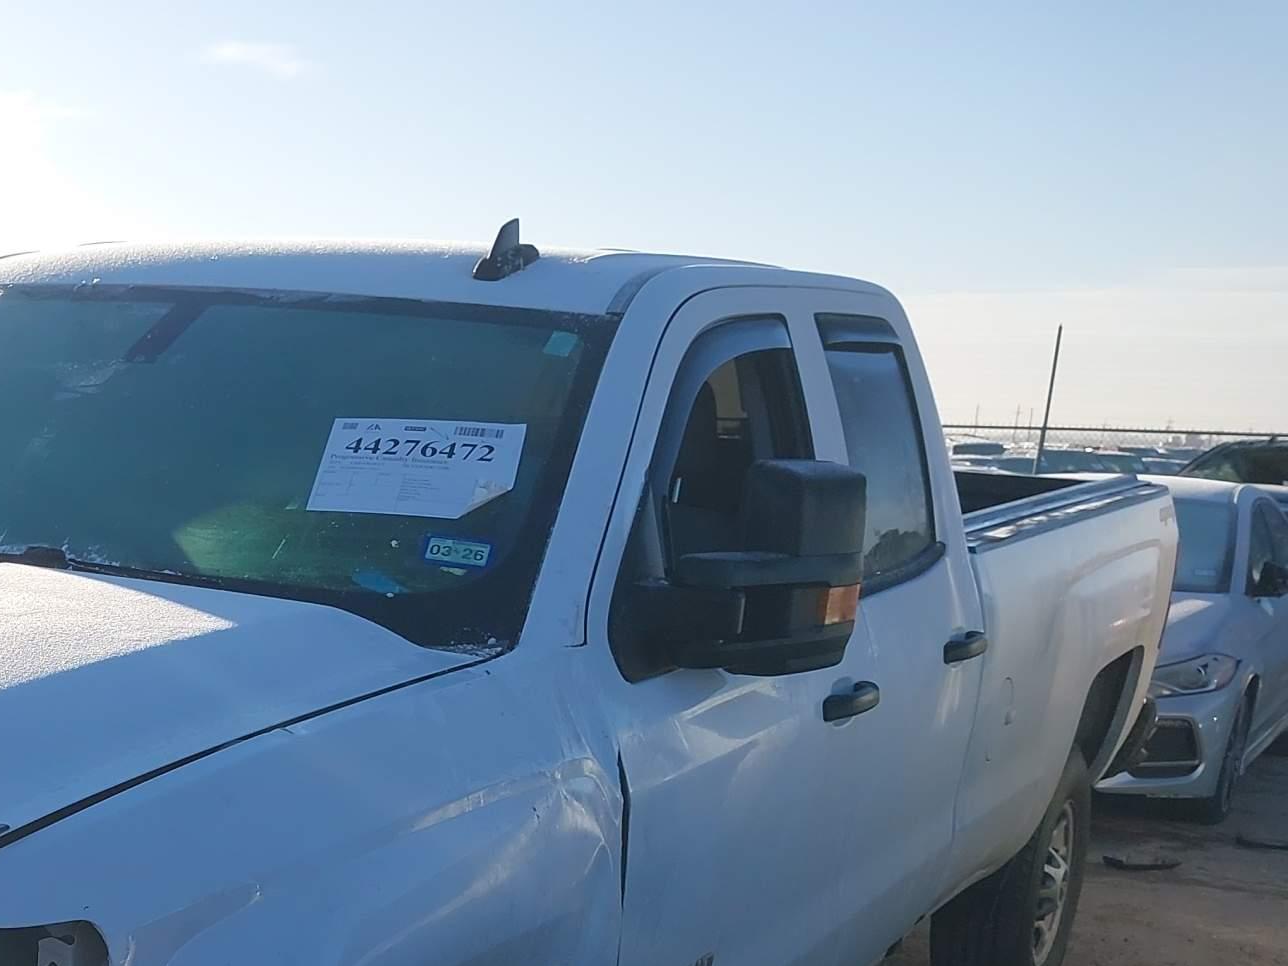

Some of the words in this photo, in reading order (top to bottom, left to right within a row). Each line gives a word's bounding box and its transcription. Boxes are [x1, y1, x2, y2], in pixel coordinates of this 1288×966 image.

[345, 437, 495, 463] 44276472
[429, 544, 452, 557] 03
[462, 548, 485, 561] 26
